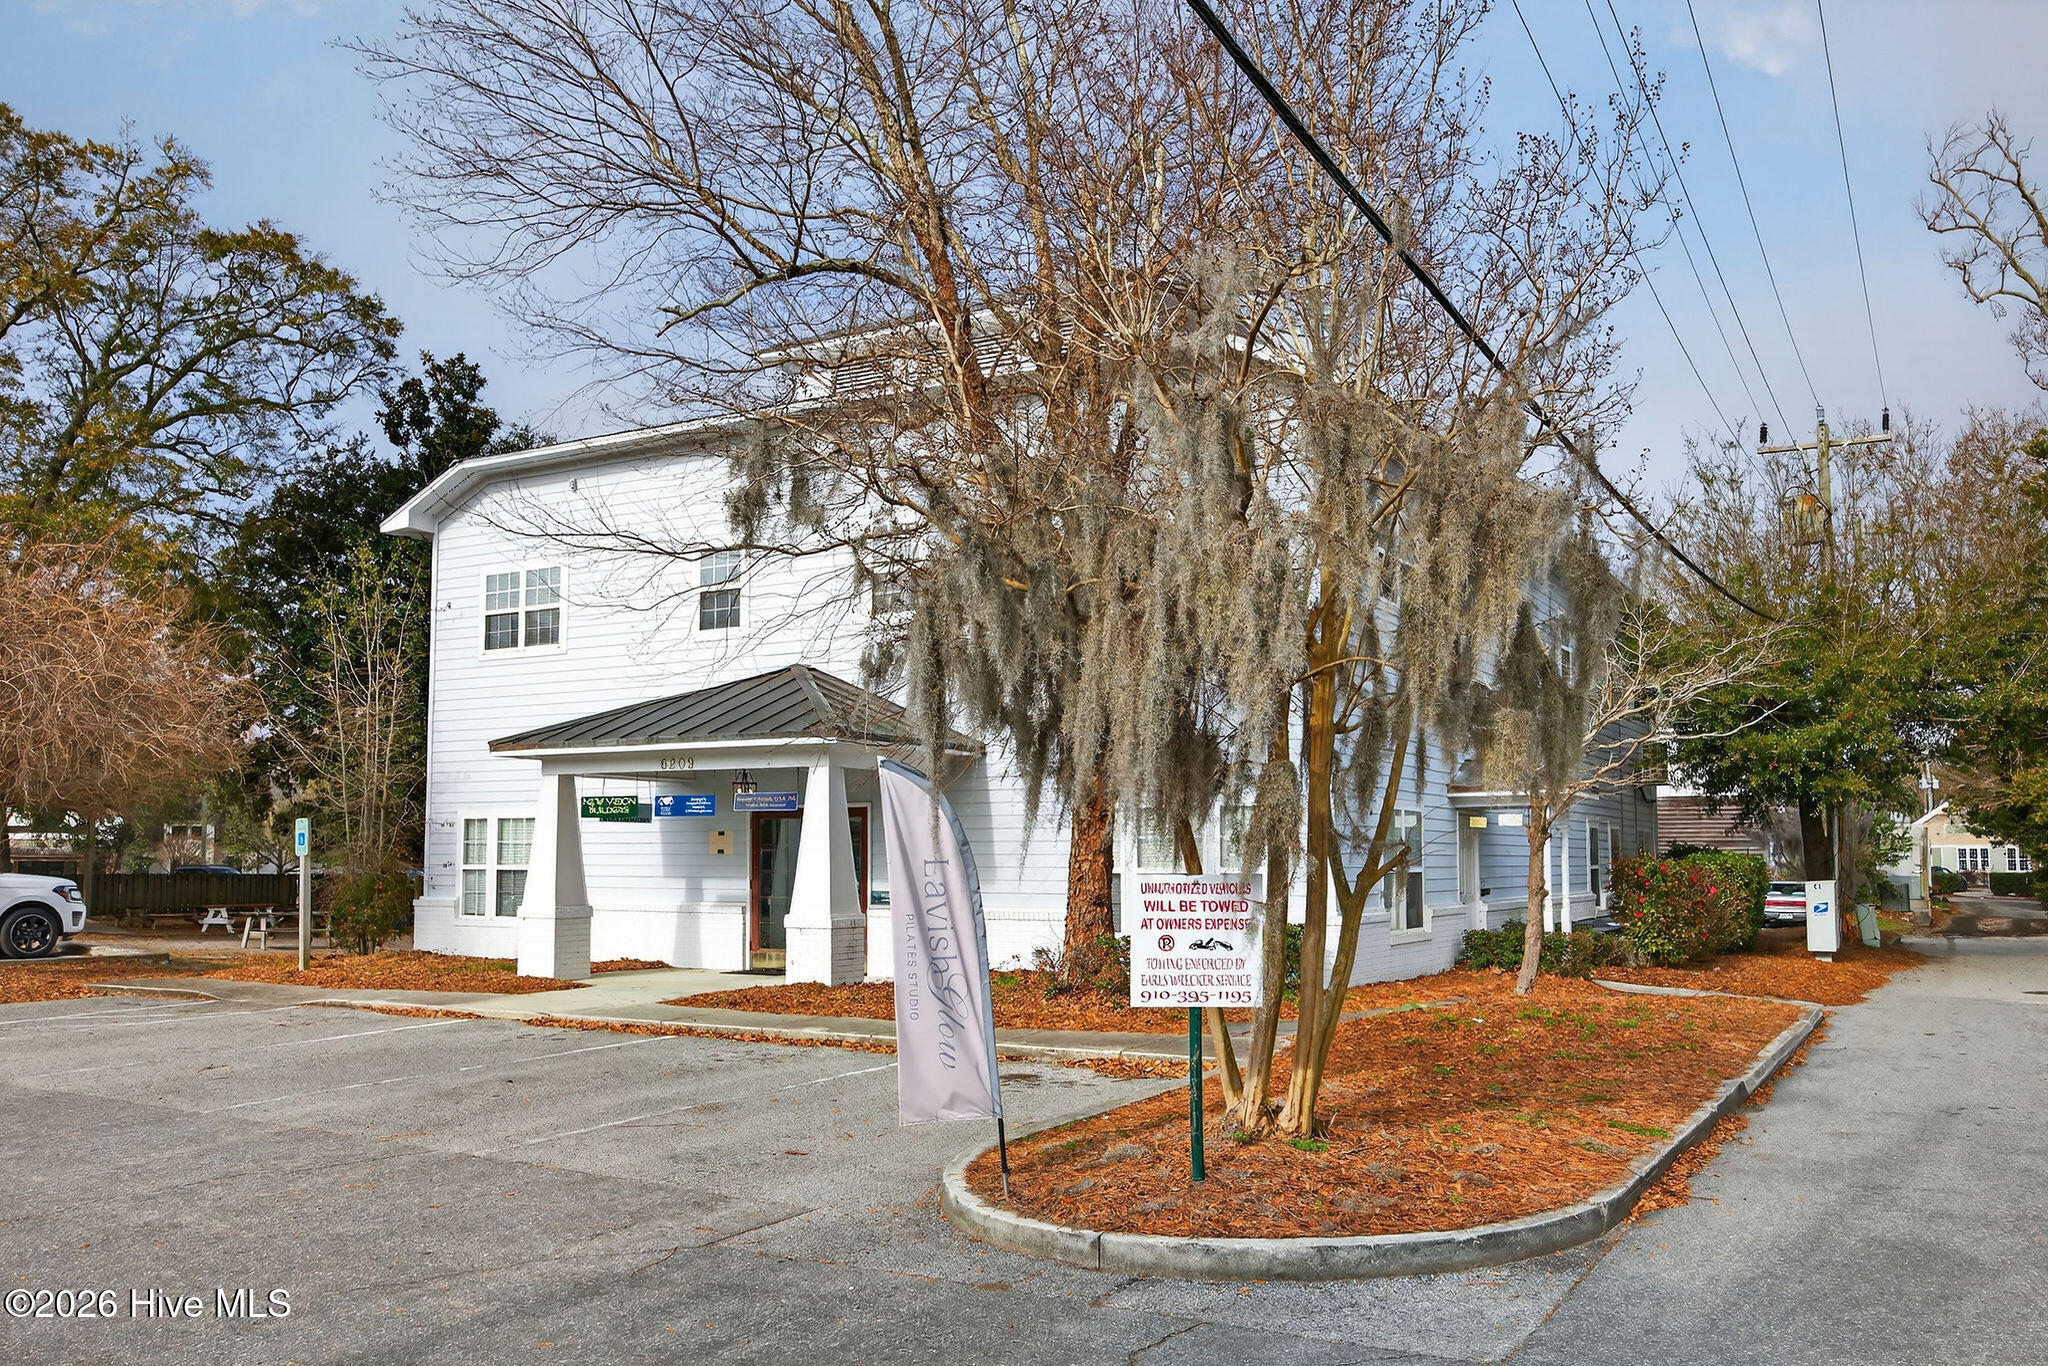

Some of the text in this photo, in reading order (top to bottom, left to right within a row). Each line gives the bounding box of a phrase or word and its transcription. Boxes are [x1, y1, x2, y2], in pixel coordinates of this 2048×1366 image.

[661, 758, 694, 769] 6209
[1140, 882, 1207, 895] UNAUTHORIZED
[1144, 900, 1249, 912] WILL BE TOWED
[1140, 918, 1154, 930] AT
[1156, 918, 1202, 930] OWNERS
[905, 913, 919, 1021] PILATES STUDIO
[1146, 958, 1247, 970] TOWING ENFORCED BY
[1168, 974, 1214, 986] WRECKER
[1215, 974, 1252, 986] SERVICE
[1140, 990, 1252, 1003] 910-395-1195
